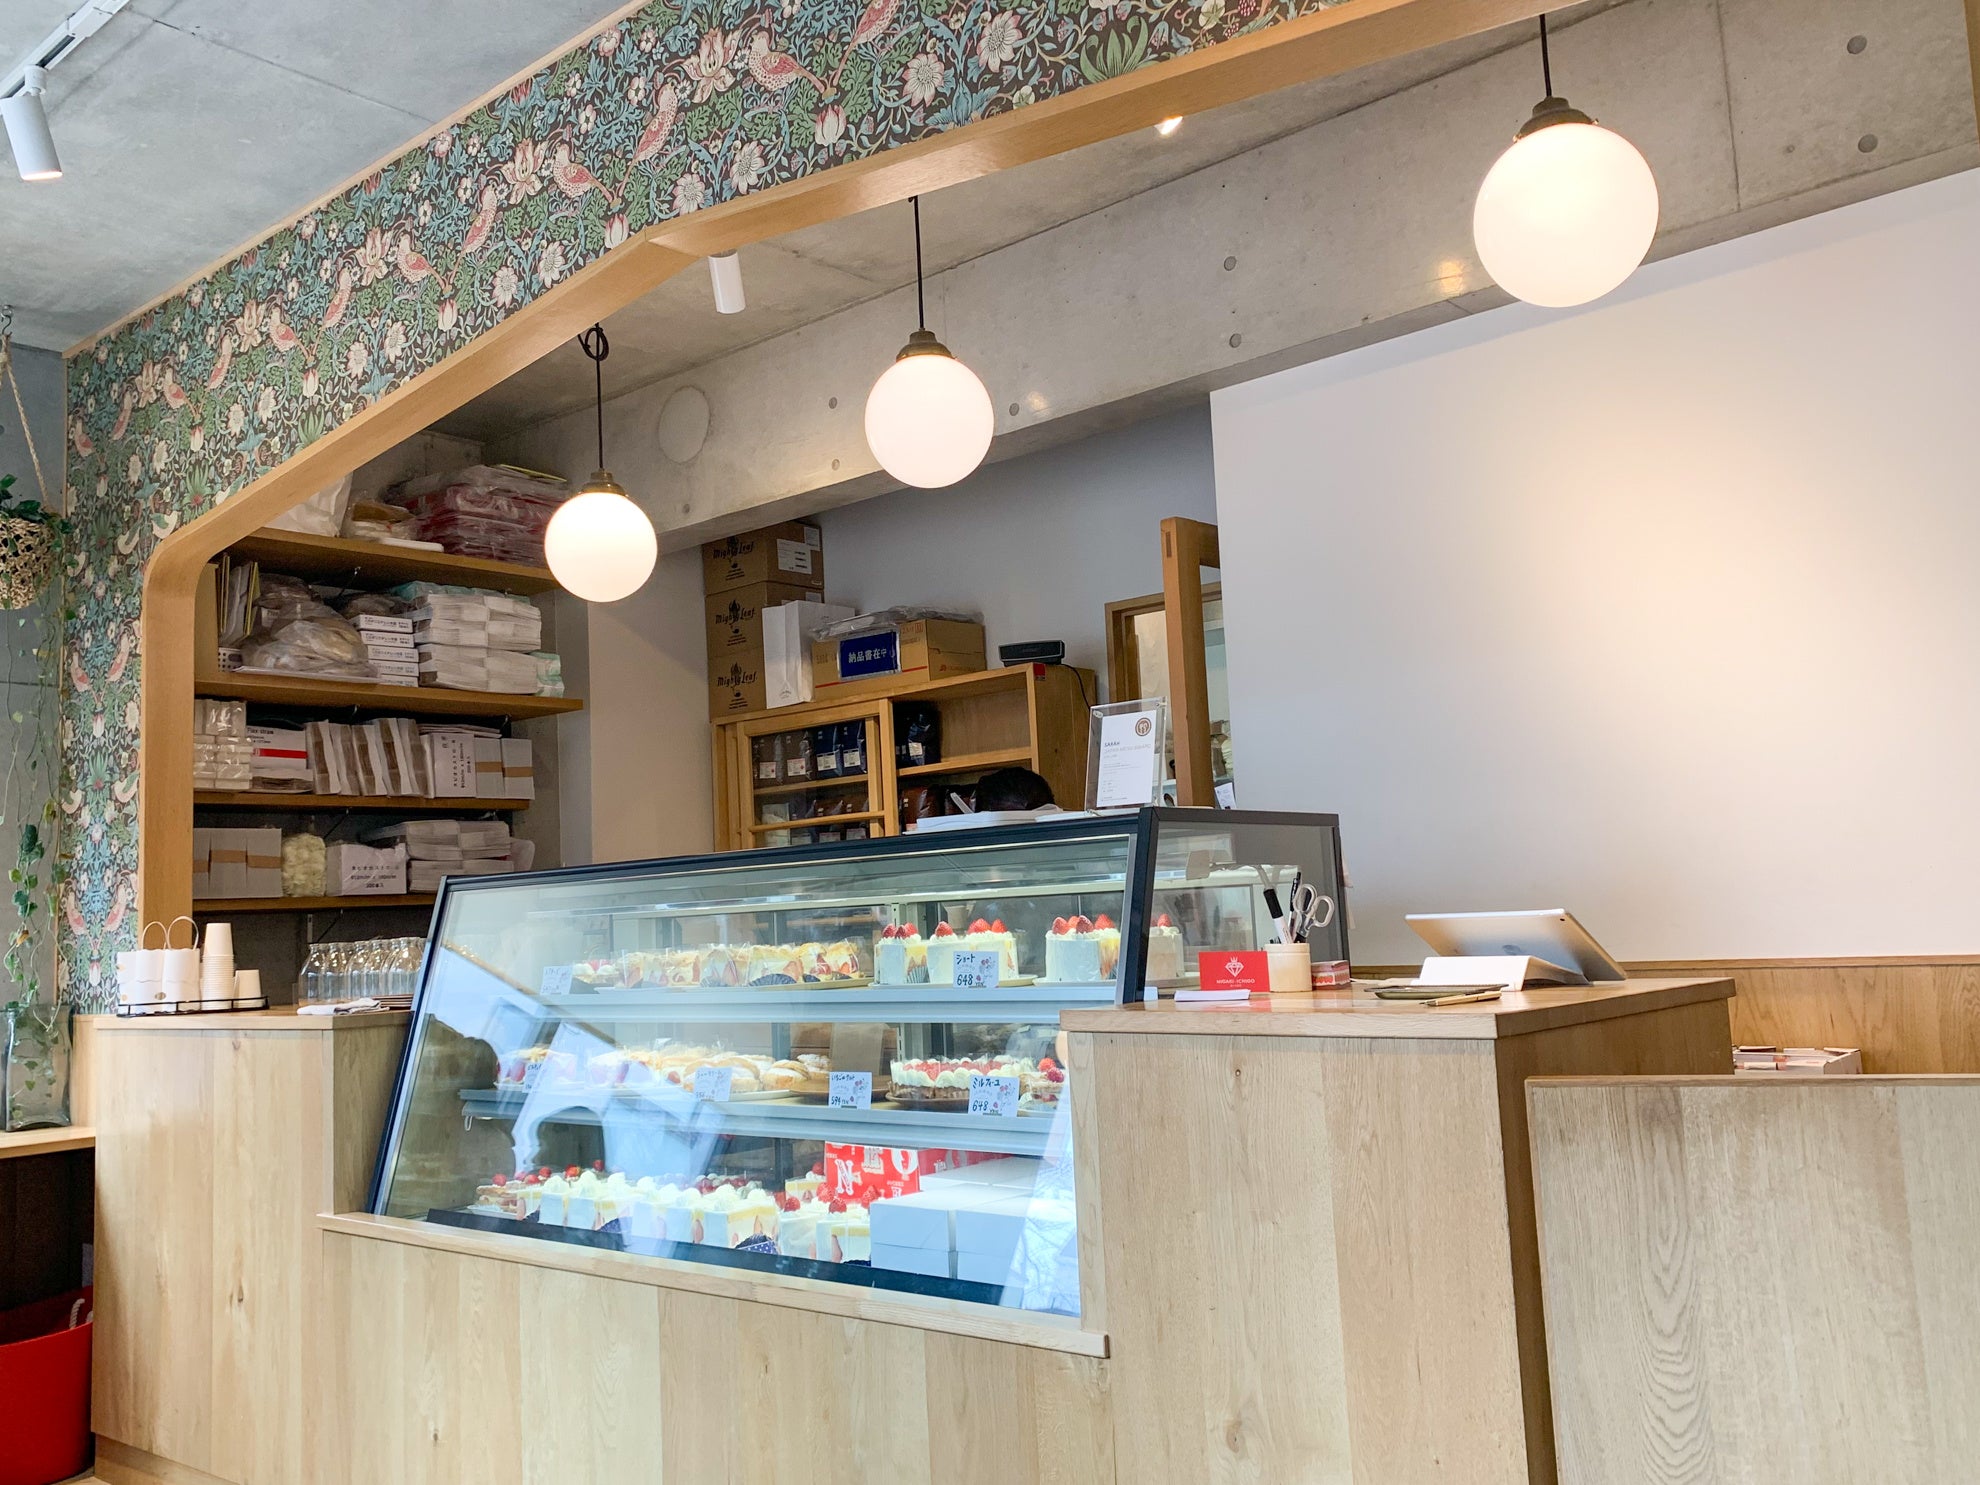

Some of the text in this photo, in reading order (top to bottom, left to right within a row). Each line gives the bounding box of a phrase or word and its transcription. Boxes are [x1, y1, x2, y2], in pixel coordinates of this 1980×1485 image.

[715, 607, 756, 626] Mighty Leaf
[717, 671, 757, 689] Mighty Leaf
[956, 953, 975, 964] ショート
[957, 974, 973, 985] 648
[972, 1100, 988, 1111] 648
